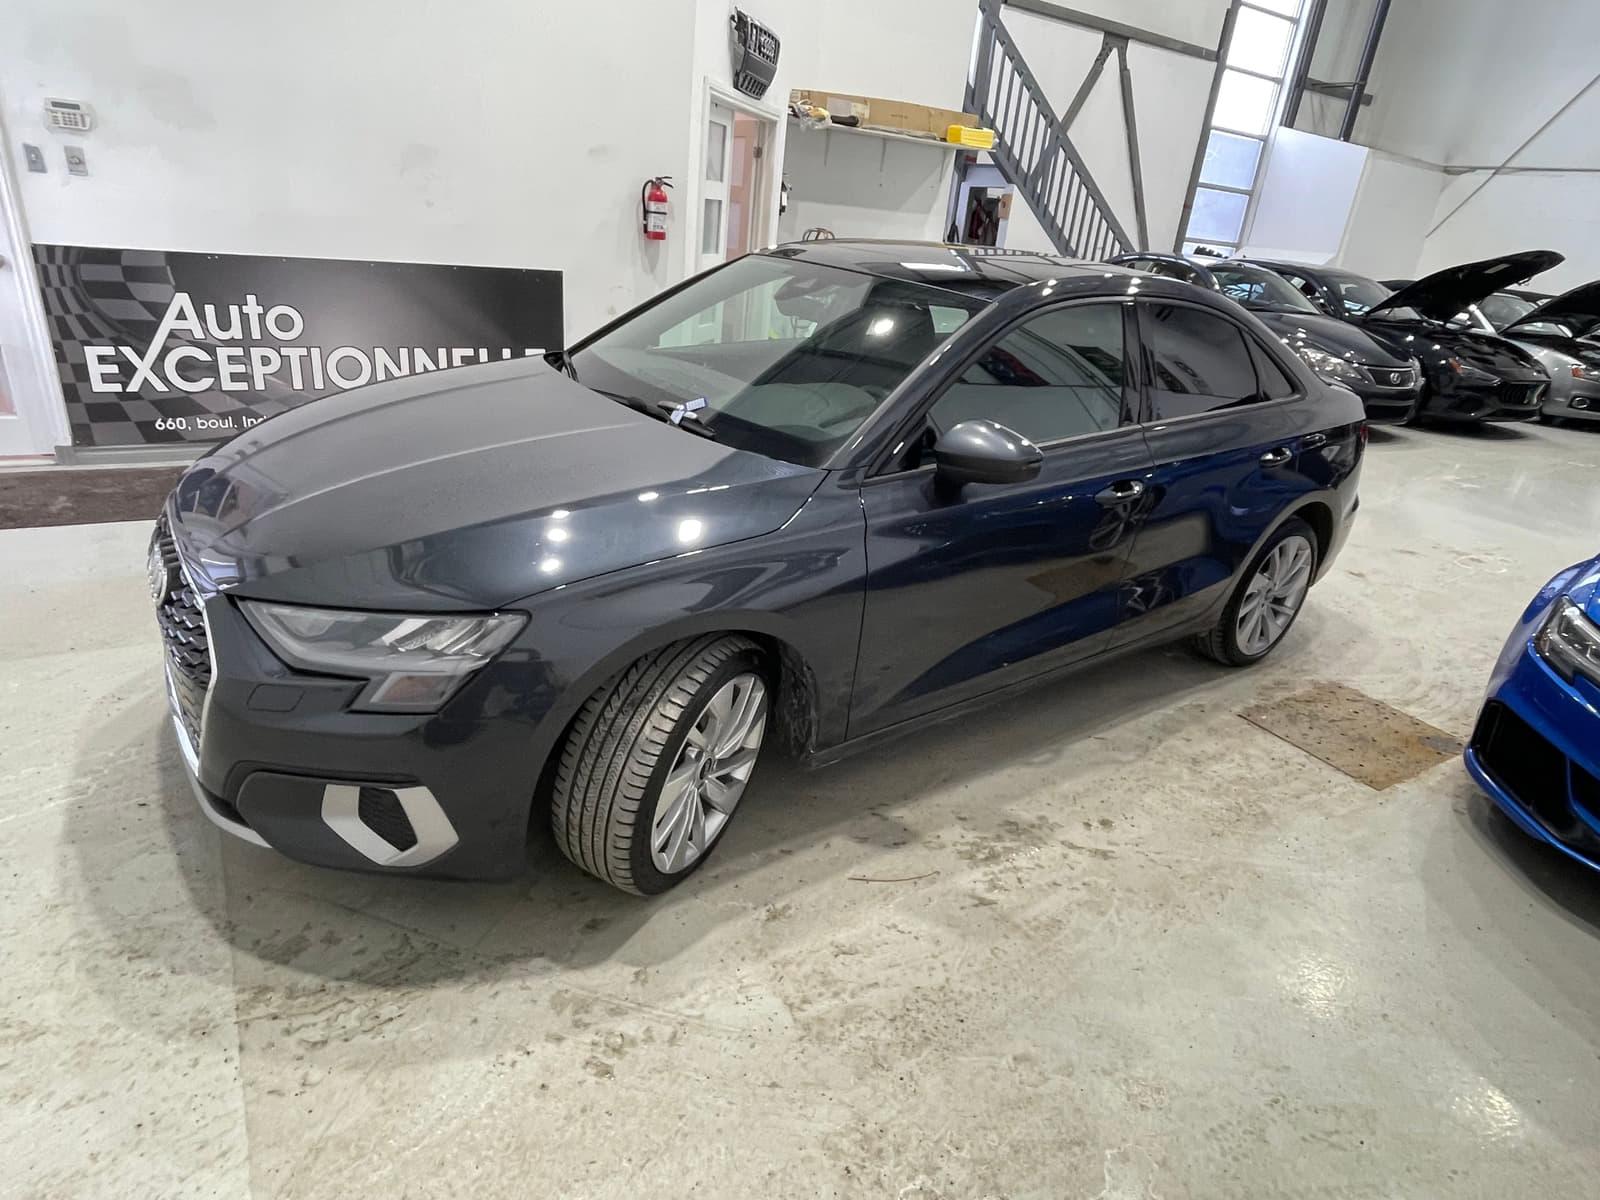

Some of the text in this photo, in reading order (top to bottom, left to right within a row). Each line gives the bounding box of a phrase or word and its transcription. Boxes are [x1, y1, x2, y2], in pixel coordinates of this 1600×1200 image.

[158, 292, 304, 341] Auto
[83, 345, 546, 393] EXCEPTIONN
[154, 417, 192, 431] 660,
[196, 416, 238, 429] boul.
